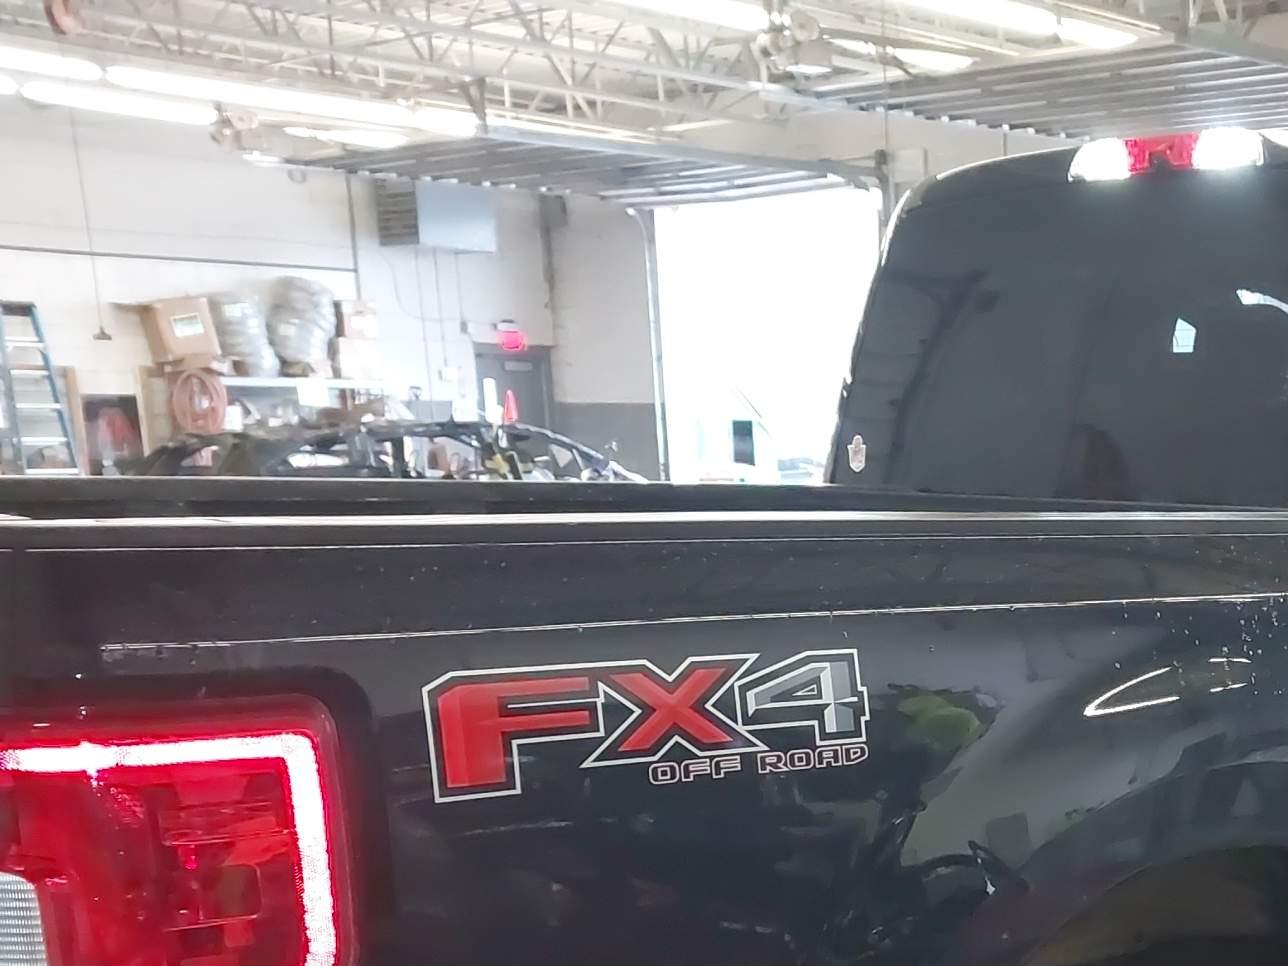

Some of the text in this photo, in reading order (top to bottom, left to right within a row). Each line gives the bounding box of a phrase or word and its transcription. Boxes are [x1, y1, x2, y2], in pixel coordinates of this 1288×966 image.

[421, 648, 870, 804] FX4
[648, 744, 869, 785] OFF ROAD
